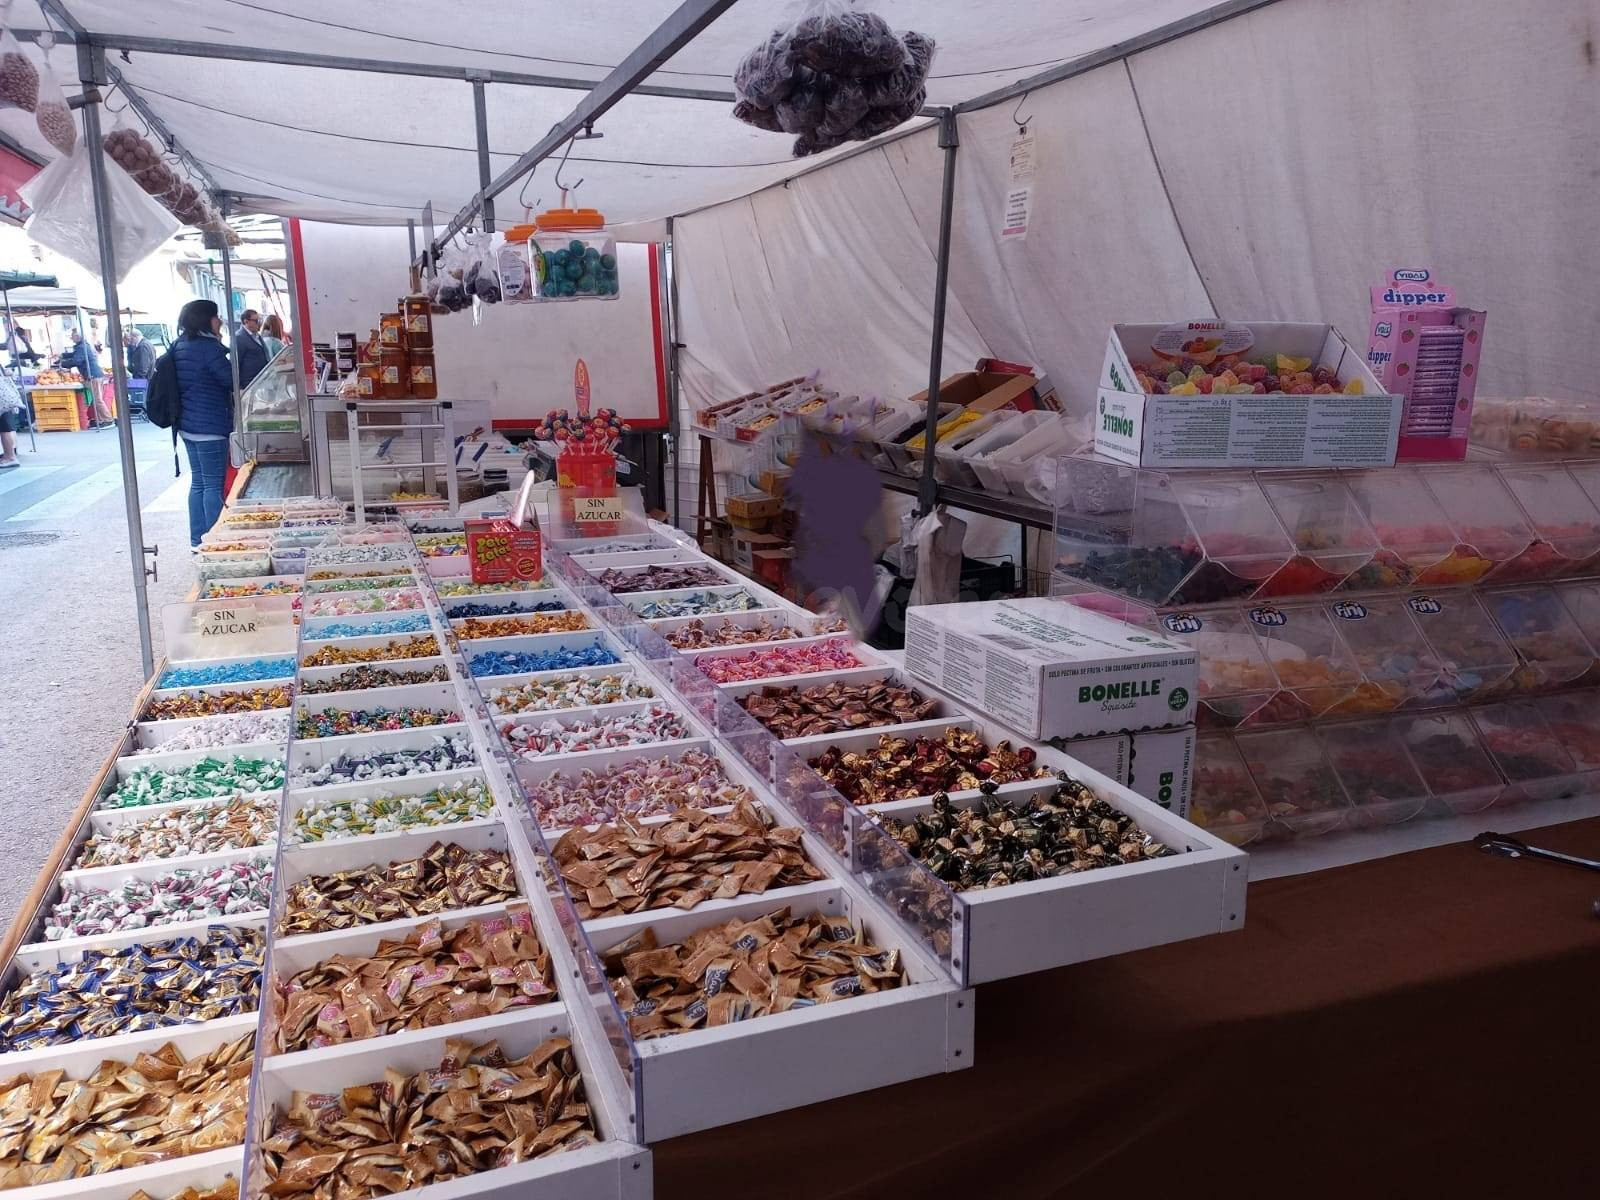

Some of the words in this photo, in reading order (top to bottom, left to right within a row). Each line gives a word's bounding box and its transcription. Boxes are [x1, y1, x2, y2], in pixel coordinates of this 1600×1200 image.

[1399, 271, 1425, 279] VIDAL
[1383, 288, 1446, 305] dipper
[1188, 322, 1226, 330] BONELLE
[1368, 347, 1392, 365] dipper
[1103, 414, 1134, 438] BONELLE
[587, 499, 605, 508] SIN
[577, 511, 621, 520] AZUCAR
[1335, 601, 1365, 618] Fini
[1411, 597, 1439, 612] Fini
[214, 610, 236, 621] SIN
[1168, 614, 1199, 631] Fini
[1252, 608, 1284, 624] Fini
[202, 622, 256, 636] AZUCAR
[1078, 679, 1161, 703] BONELLE
